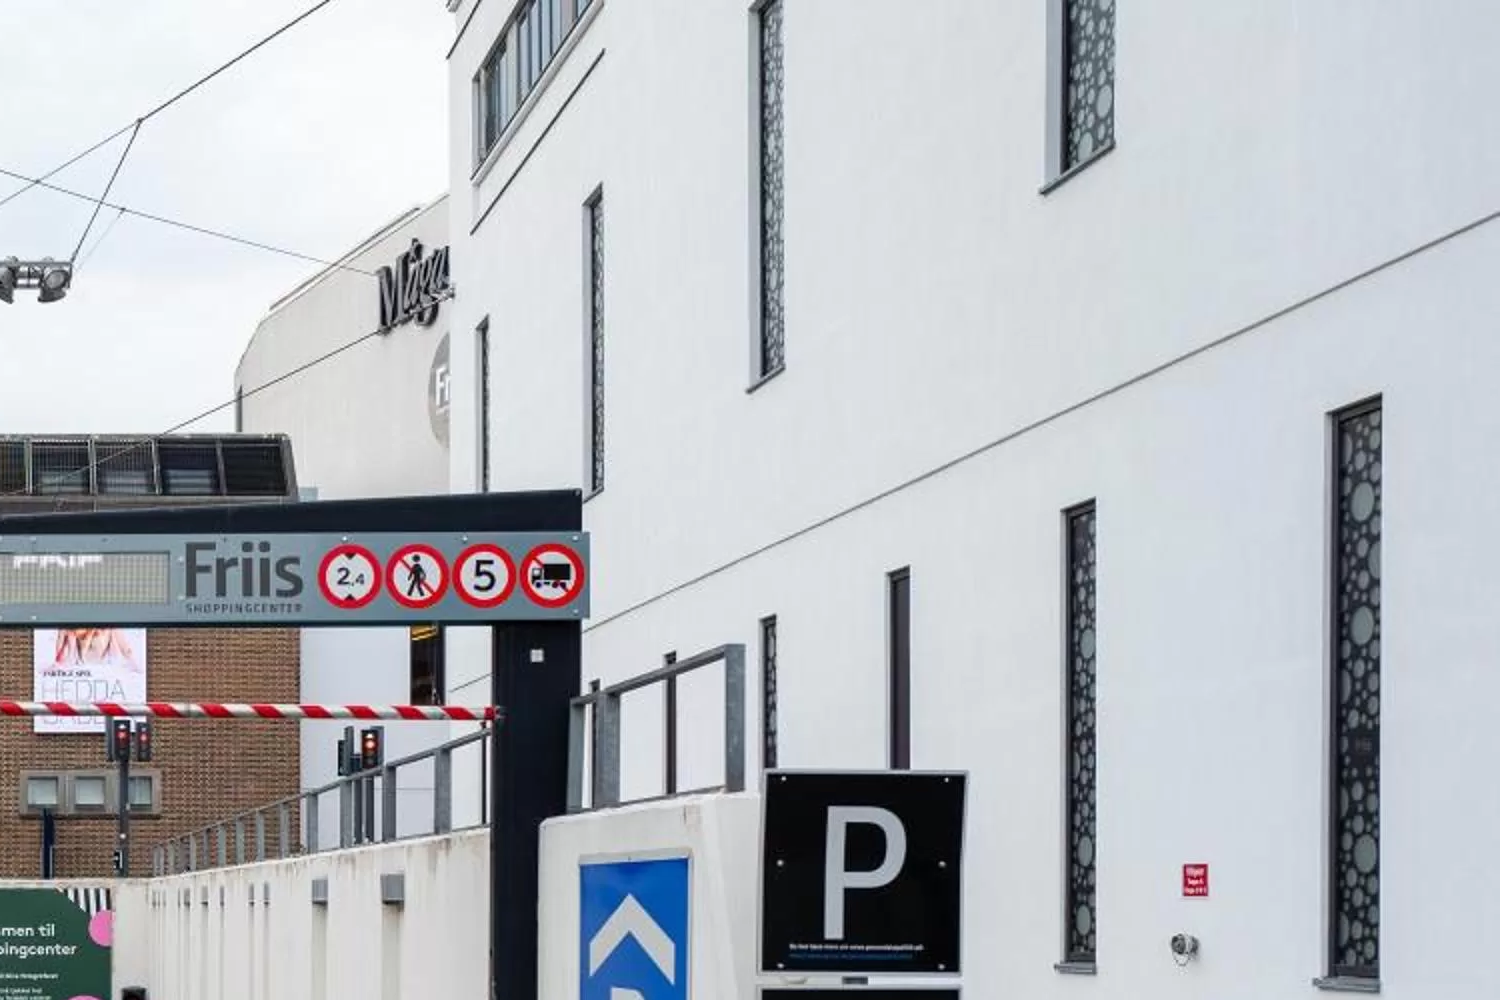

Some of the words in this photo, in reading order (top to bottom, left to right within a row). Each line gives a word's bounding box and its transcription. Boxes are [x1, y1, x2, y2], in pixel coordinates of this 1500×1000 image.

[186, 541, 303, 598] Friis
[473, 560, 496, 592] 5
[41, 679, 126, 702] HEDDA
[824, 805, 907, 940] P
[38, 923, 55, 937] til
